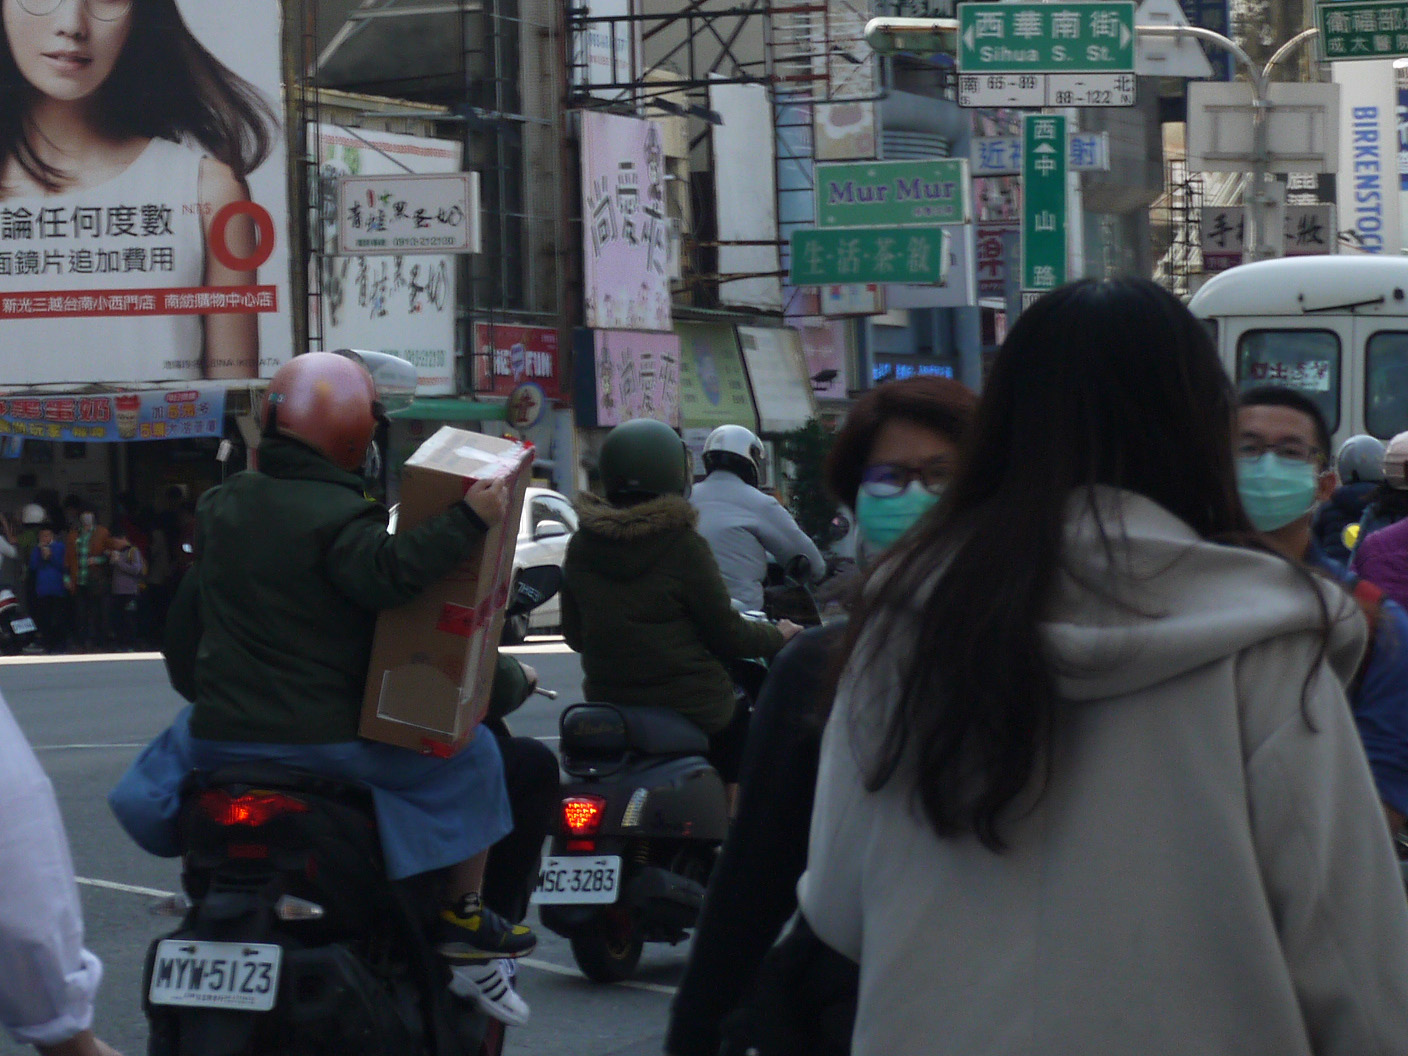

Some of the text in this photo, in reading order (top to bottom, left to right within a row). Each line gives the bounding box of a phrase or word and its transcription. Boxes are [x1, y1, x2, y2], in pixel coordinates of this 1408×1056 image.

[975, 9, 1120, 40] 西華南街
[1326, 10, 1408, 33] 衛福部
[979, 46, 1040, 62] Sihua
[1086, 45, 1116, 61] St.
[827, 177, 956, 205] Mur Mur
[1034, 155, 1057, 286] 中山路
[156, 957, 273, 994] MYW-5123
